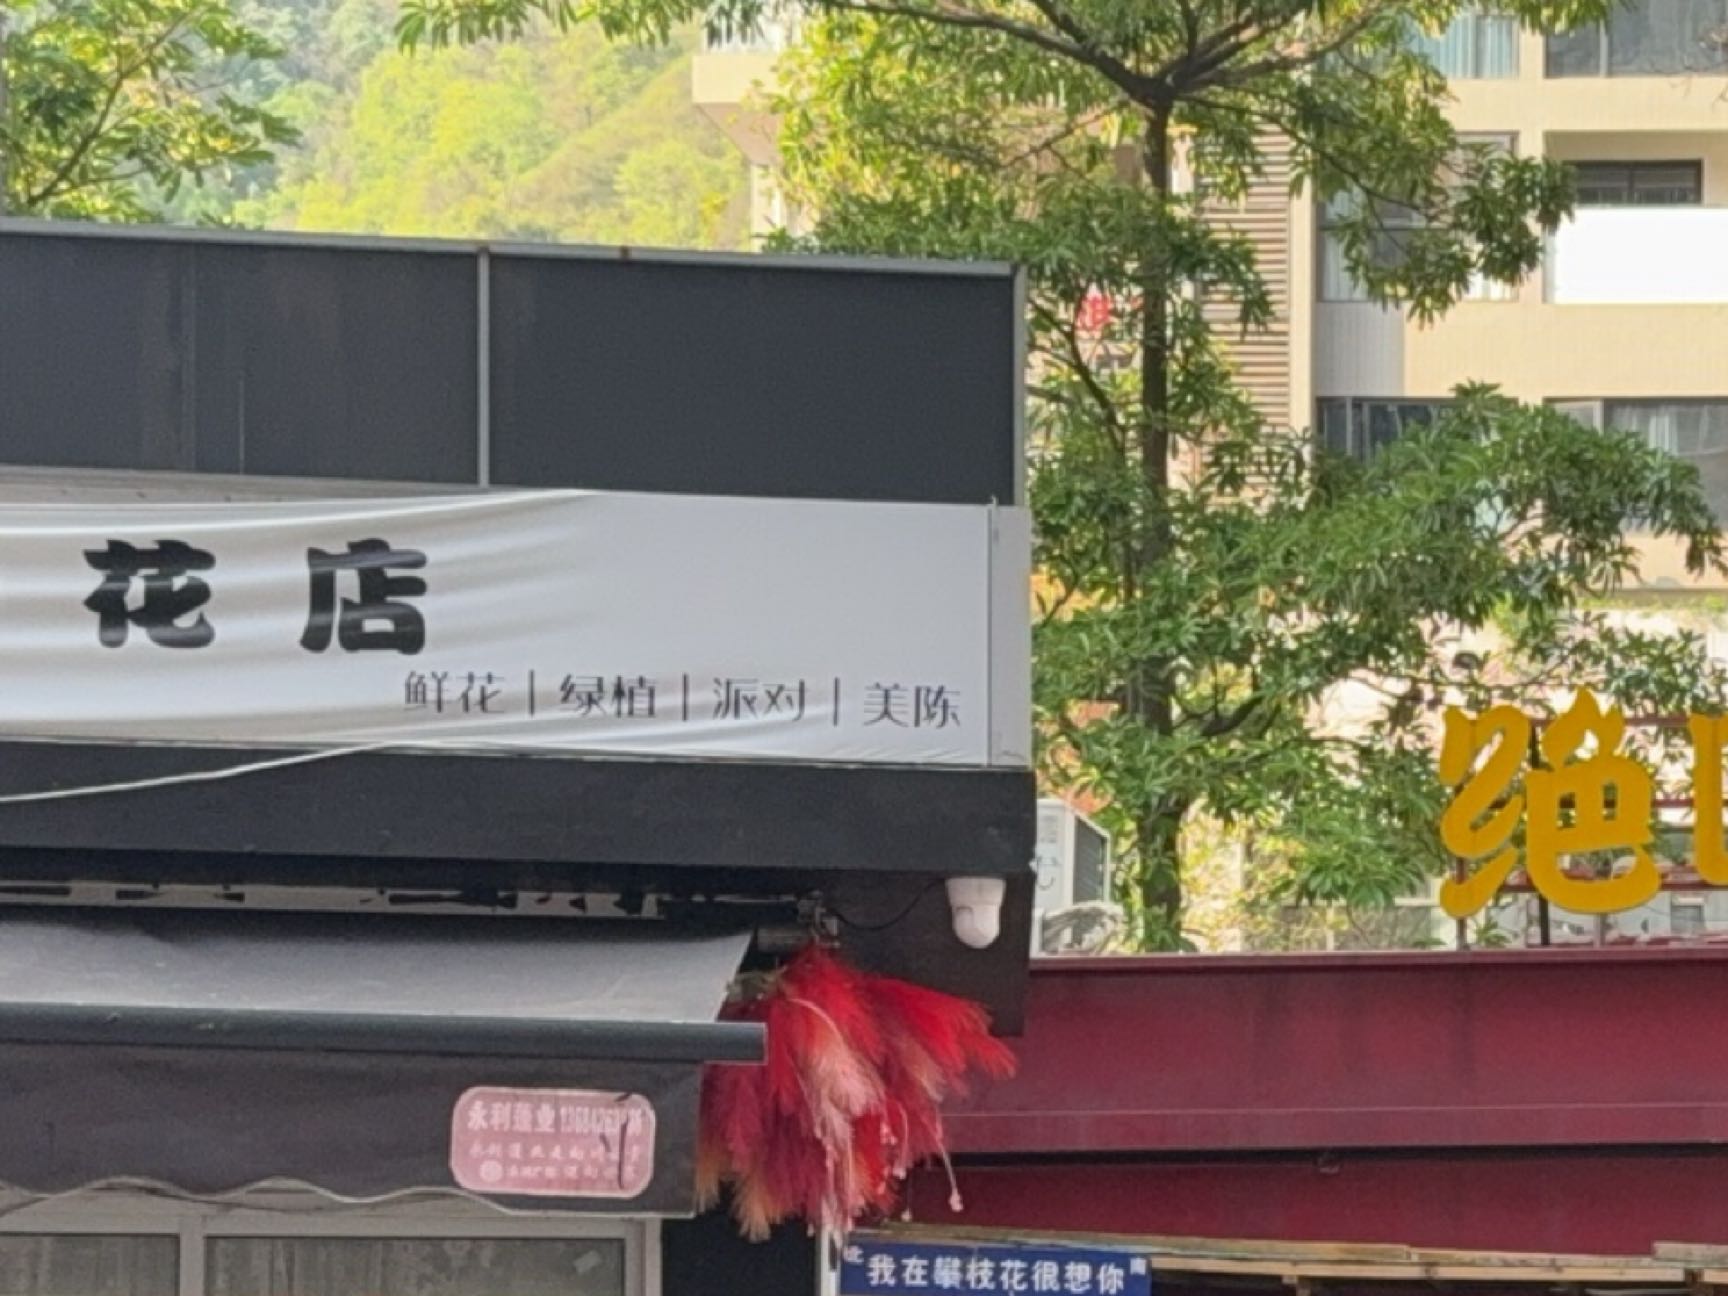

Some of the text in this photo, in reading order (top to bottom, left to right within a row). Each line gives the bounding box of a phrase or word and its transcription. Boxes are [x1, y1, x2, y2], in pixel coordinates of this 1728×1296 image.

[83, 537, 429, 655] 花店
[404, 670, 504, 715] 鲜花
[711, 677, 807, 724] 派对
[863, 682, 961, 730] 美陈
[867, 1253, 1125, 1295] 我在攀枝花很想你
